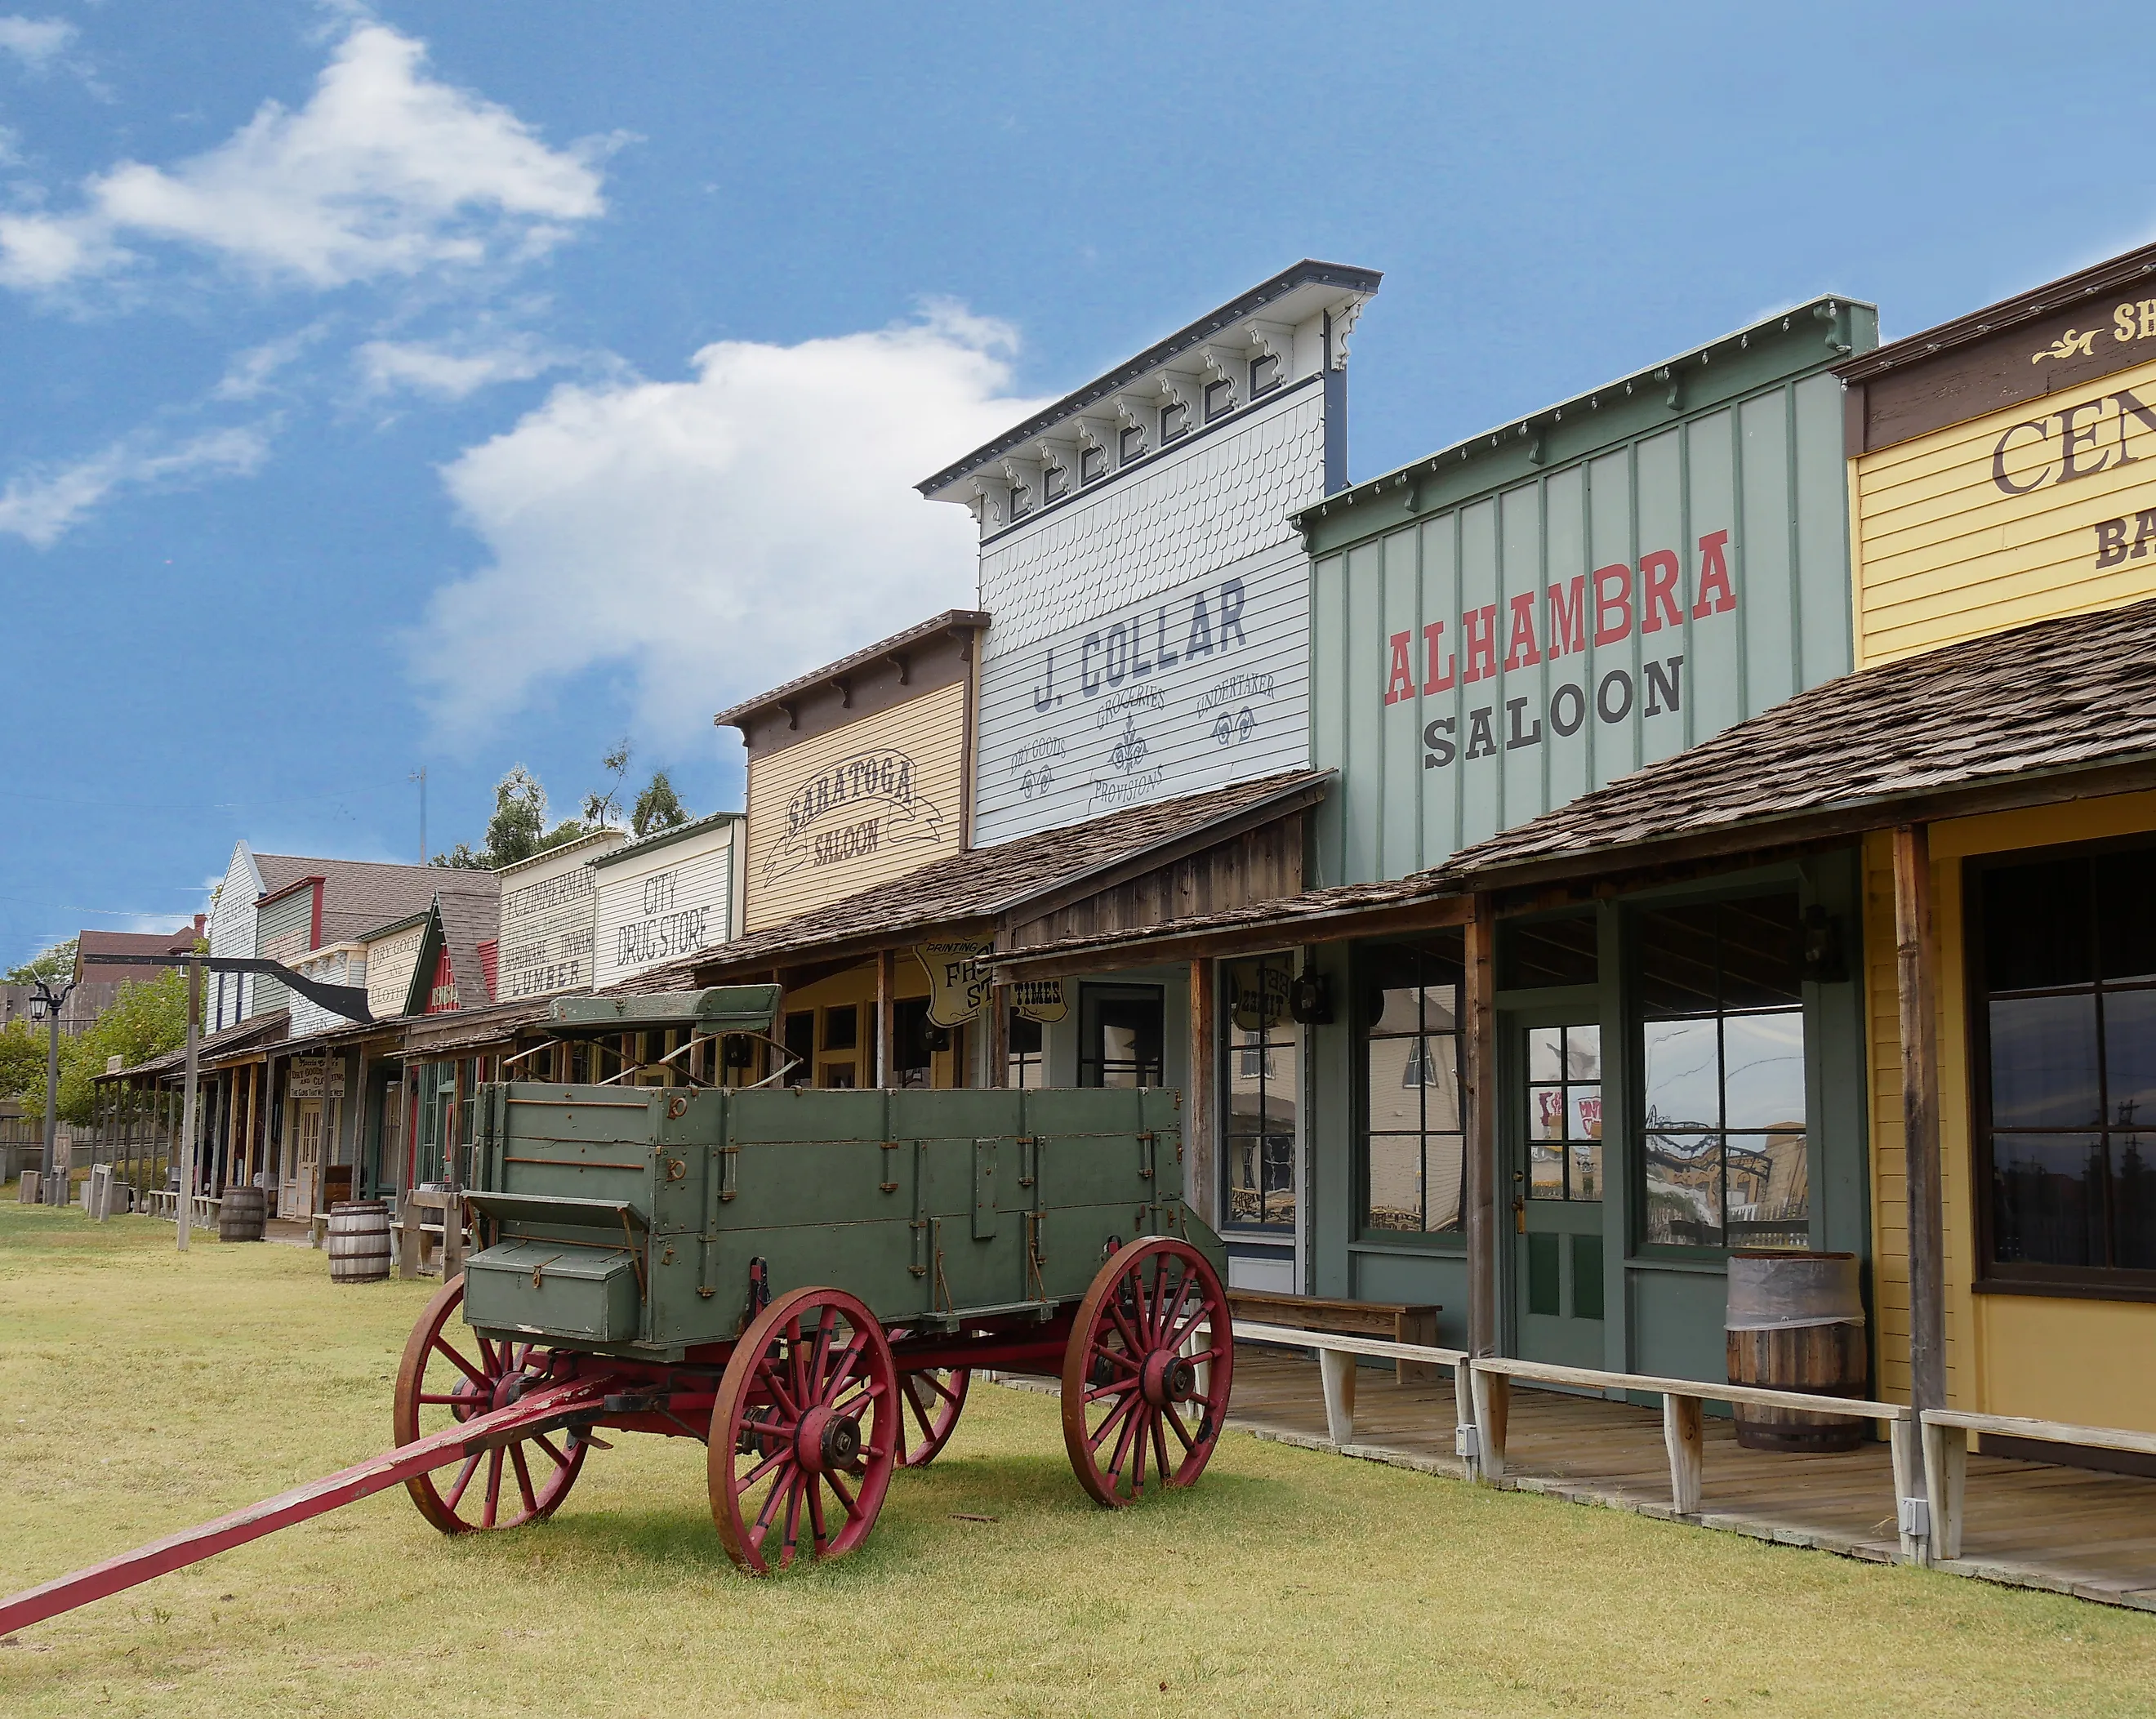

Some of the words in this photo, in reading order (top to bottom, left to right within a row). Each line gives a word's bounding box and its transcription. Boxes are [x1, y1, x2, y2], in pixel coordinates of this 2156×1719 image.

[1991, 389, 2156, 496] CEN
[2094, 508, 2156, 569] BA
[1383, 528, 1737, 707] ALHAMBRA
[1033, 648, 1062, 714] J.
[1080, 576, 1247, 699] COLLAR
[1096, 684, 1166, 730] GROCERIES
[1196, 672, 1275, 719] UNDERTAKER
[1423, 654, 1685, 770] SALOON
[1009, 744, 1032, 777] DRY
[1031, 737, 1067, 760] GOODS
[787, 757, 912, 835] SARATOGA
[1094, 764, 1165, 804] PROVISIONS
[813, 817, 882, 867] SALOON
[644, 869, 679, 915] CITY
[372, 943, 391, 971] DRY
[393, 933, 422, 955] GOOD
[617, 919, 657, 967] DRUG
[660, 905, 710, 958] STORE
[926, 942, 978, 953] PRINTING
[512, 960, 579, 996] LUMBER
[1014, 982, 1062, 1005] TIMES
[292, 1070, 305, 1079] DRY
